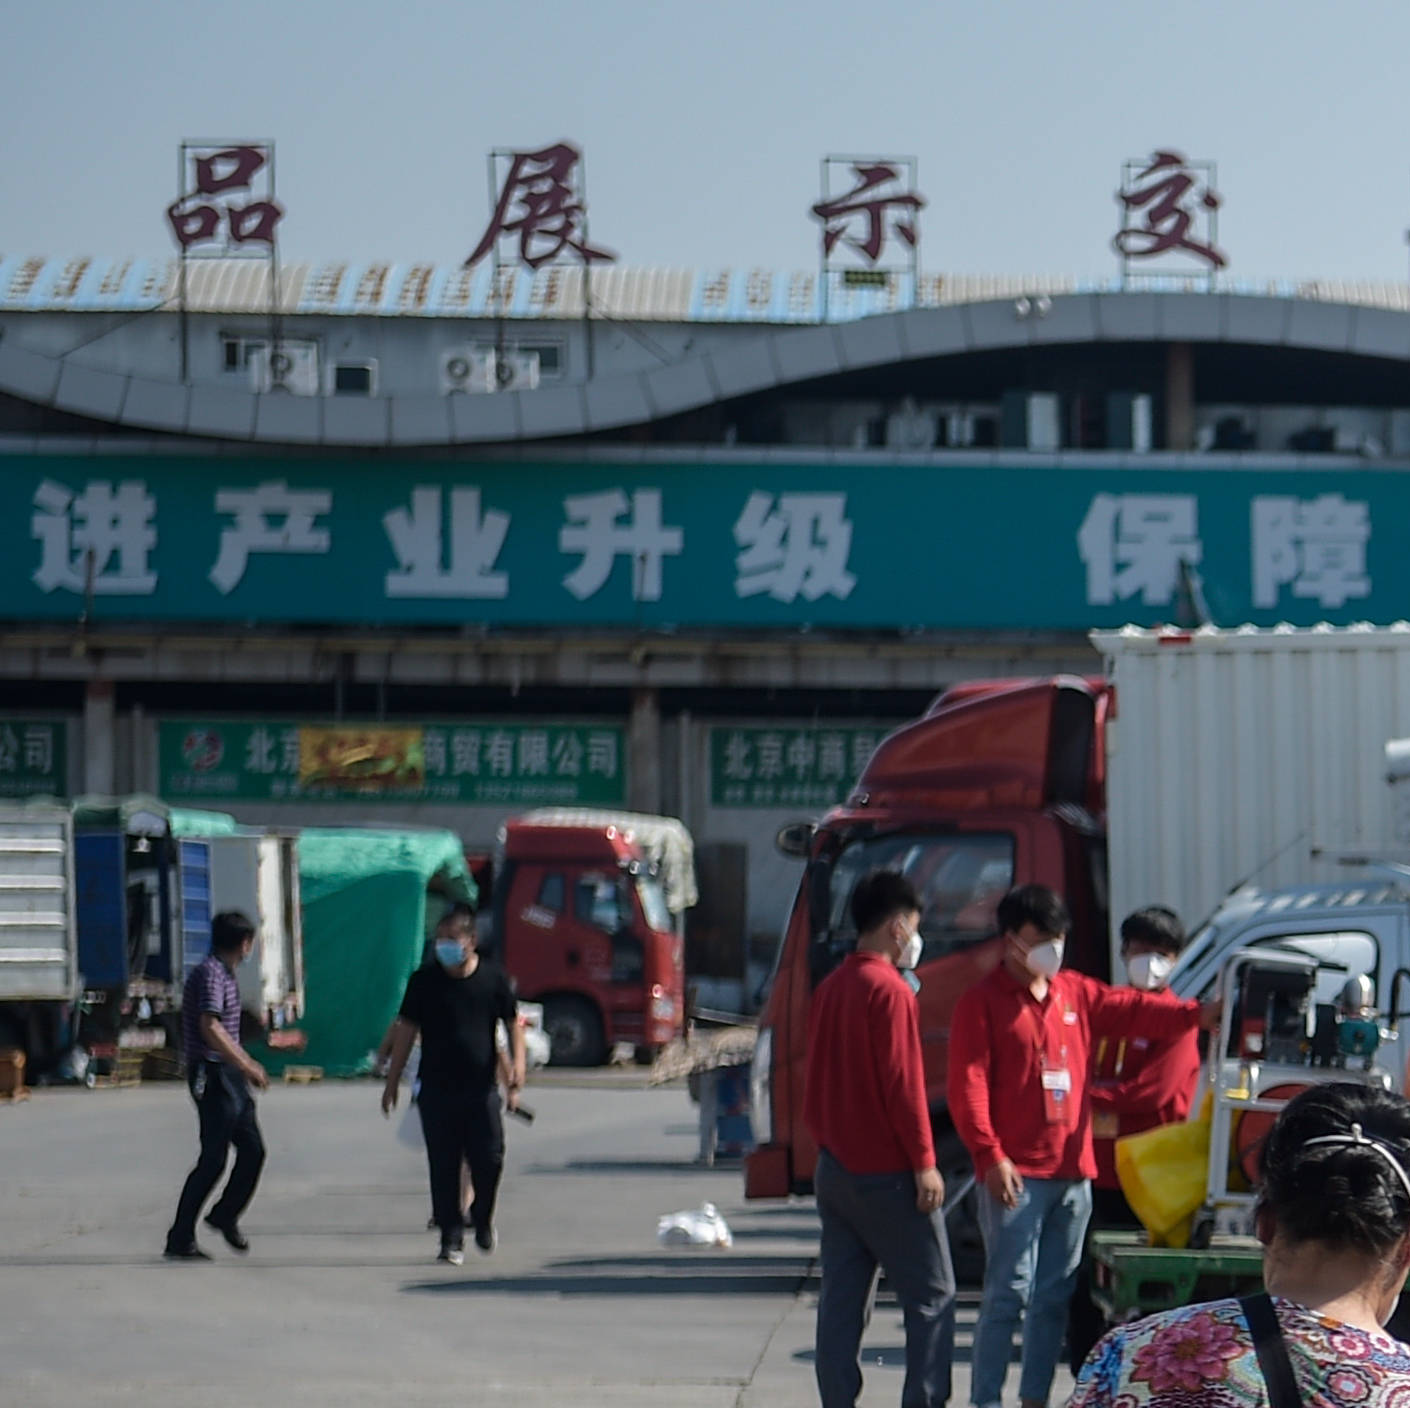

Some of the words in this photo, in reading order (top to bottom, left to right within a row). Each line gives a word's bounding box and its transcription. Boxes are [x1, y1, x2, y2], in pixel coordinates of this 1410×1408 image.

[31, 479, 857, 602] 进产业升级
